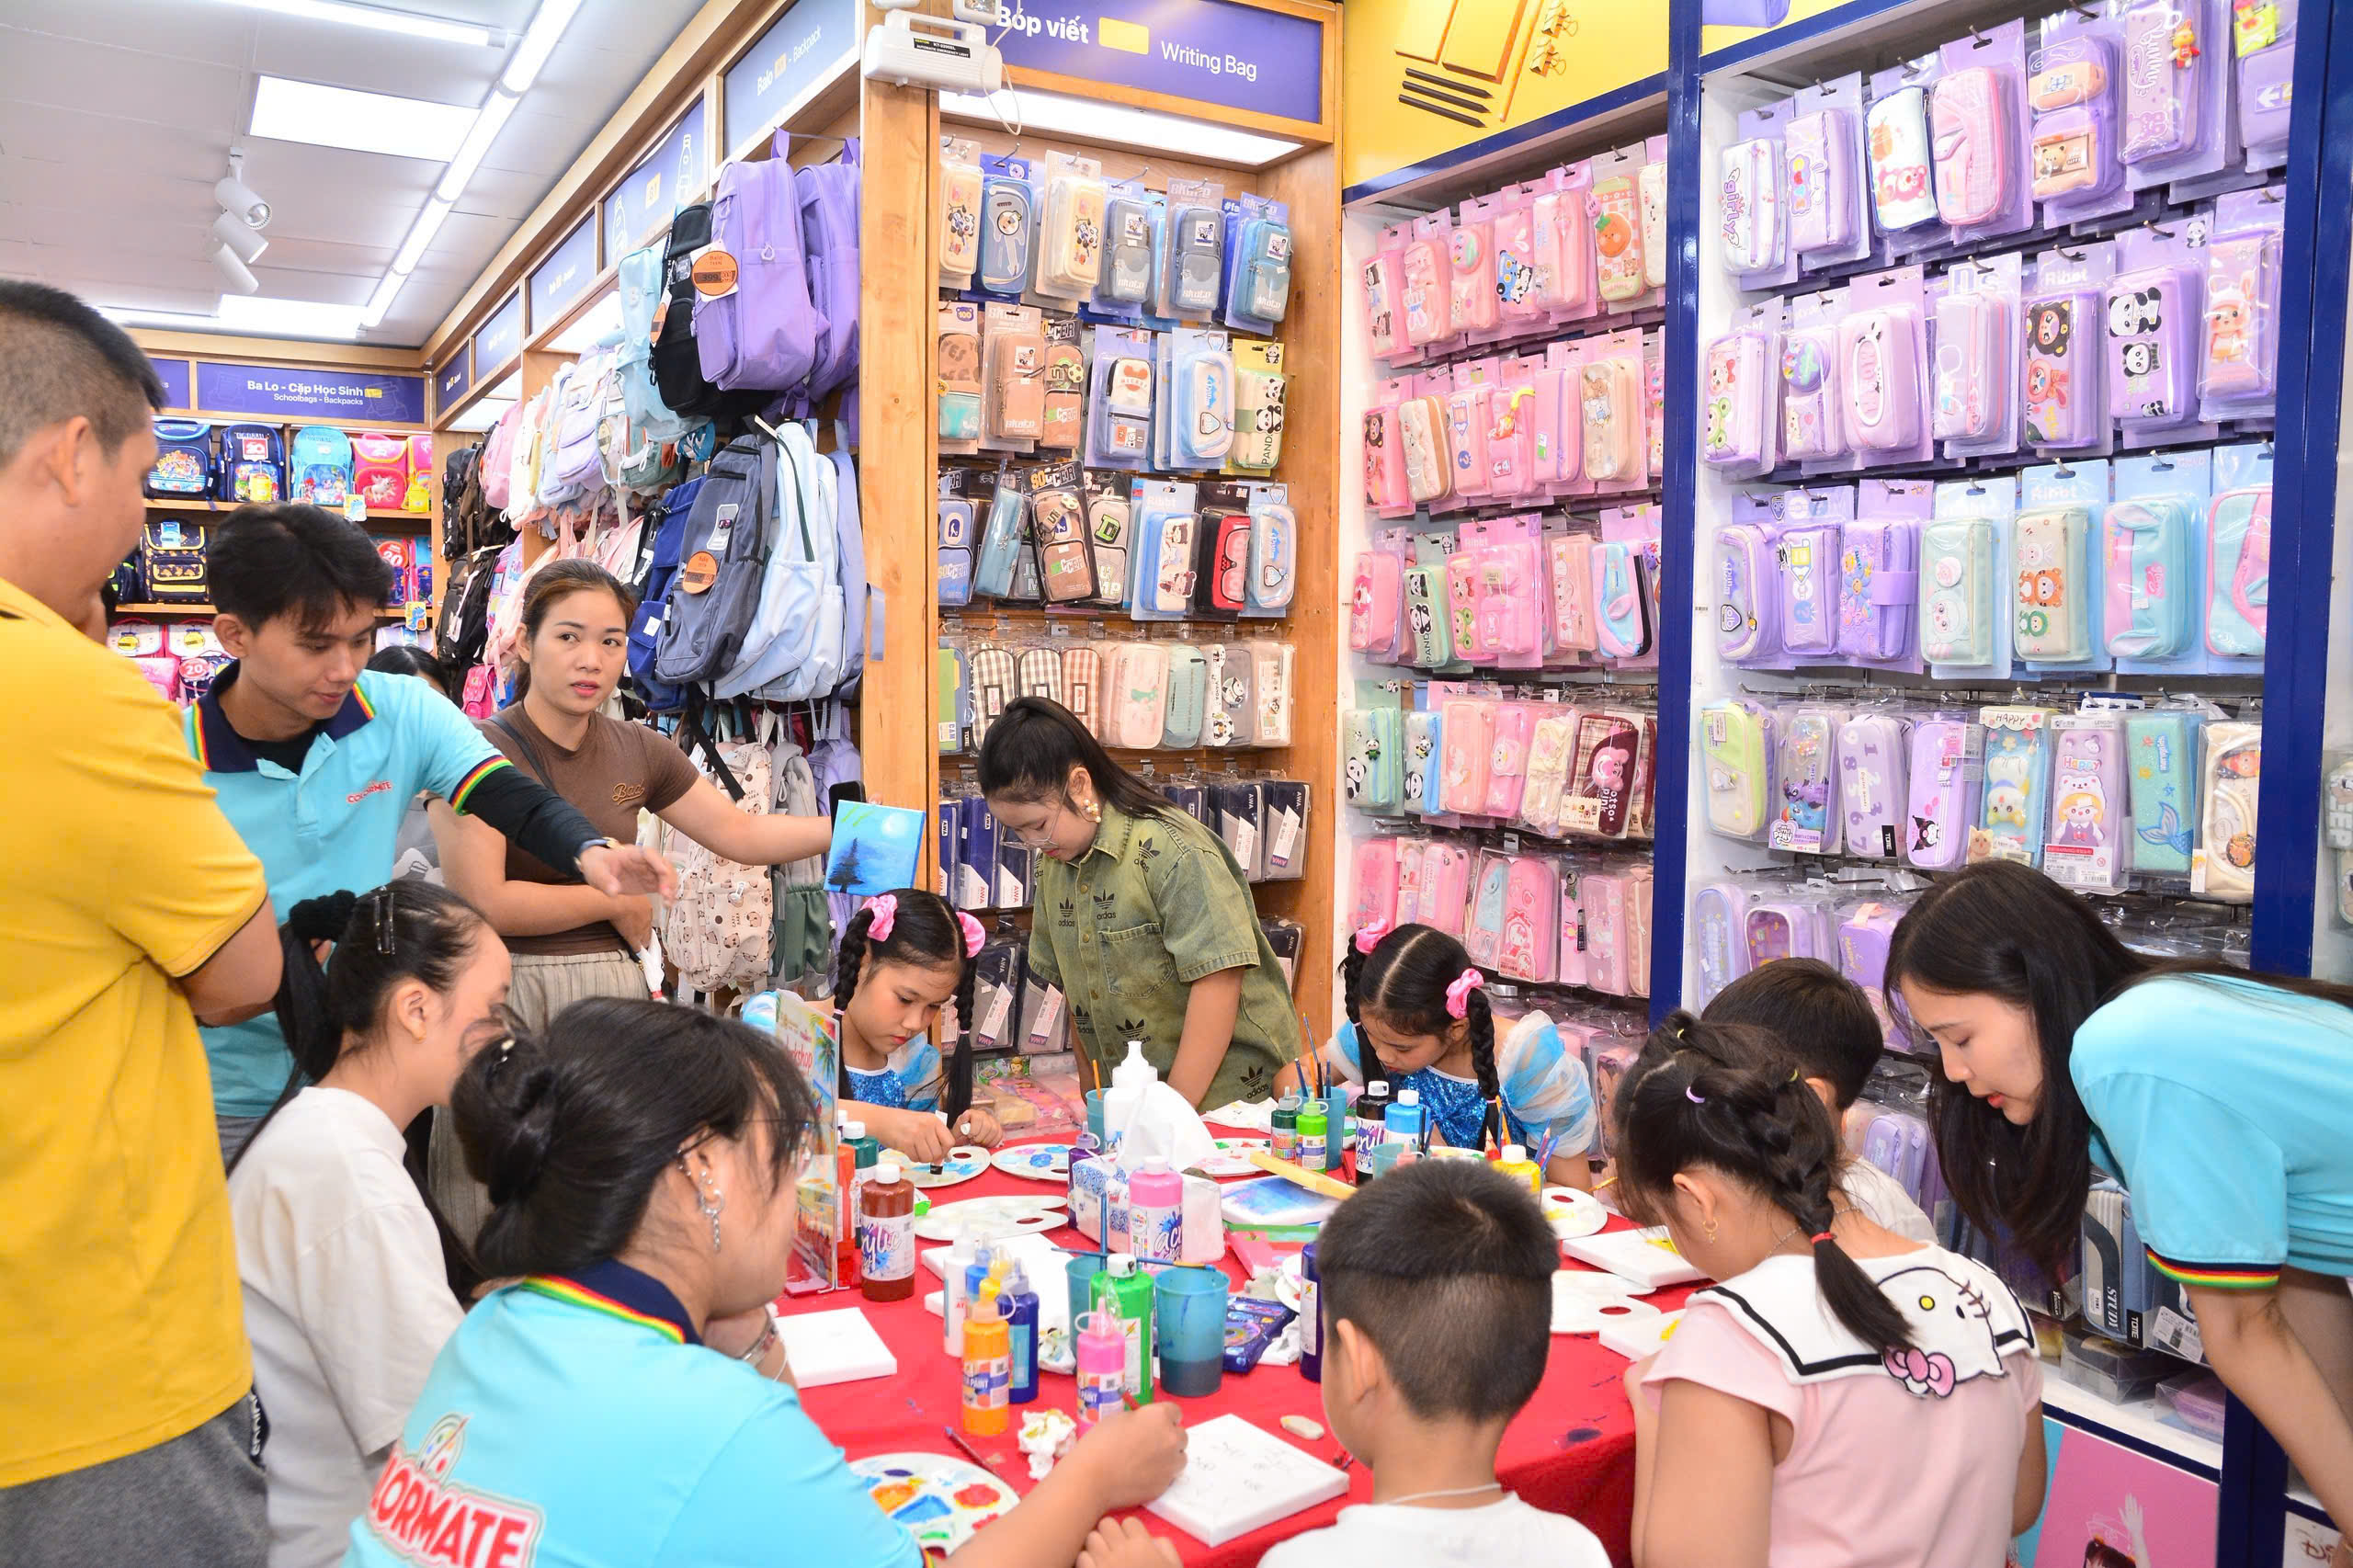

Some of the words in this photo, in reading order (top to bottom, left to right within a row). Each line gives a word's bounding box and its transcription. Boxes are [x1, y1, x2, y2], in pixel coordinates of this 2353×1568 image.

[996, 6, 1040, 38] Bóp
[1048, 16, 1088, 44] viết
[757, 69, 773, 96] Balo
[793, 25, 822, 62] Backpack
[1161, 40, 1221, 74] Writing
[1225, 54, 1257, 82] Bag
[1724, 179, 1737, 237] girly
[247, 381, 263, 391] Ba
[265, 381, 278, 392] Lo
[289, 382, 312, 398] Cặp
[338, 384, 363, 396] Sinh
[274, 392, 317, 403] Schoolbags
[324, 395, 363, 405] Backpacks
[1262, 433, 1273, 465] PAND
[1995, 713, 2025, 725] HAPPY
[2063, 756, 2101, 772] Happy
[1247, 1085, 1269, 1099] adidas
[2131, 1316, 2139, 1339] TOME
